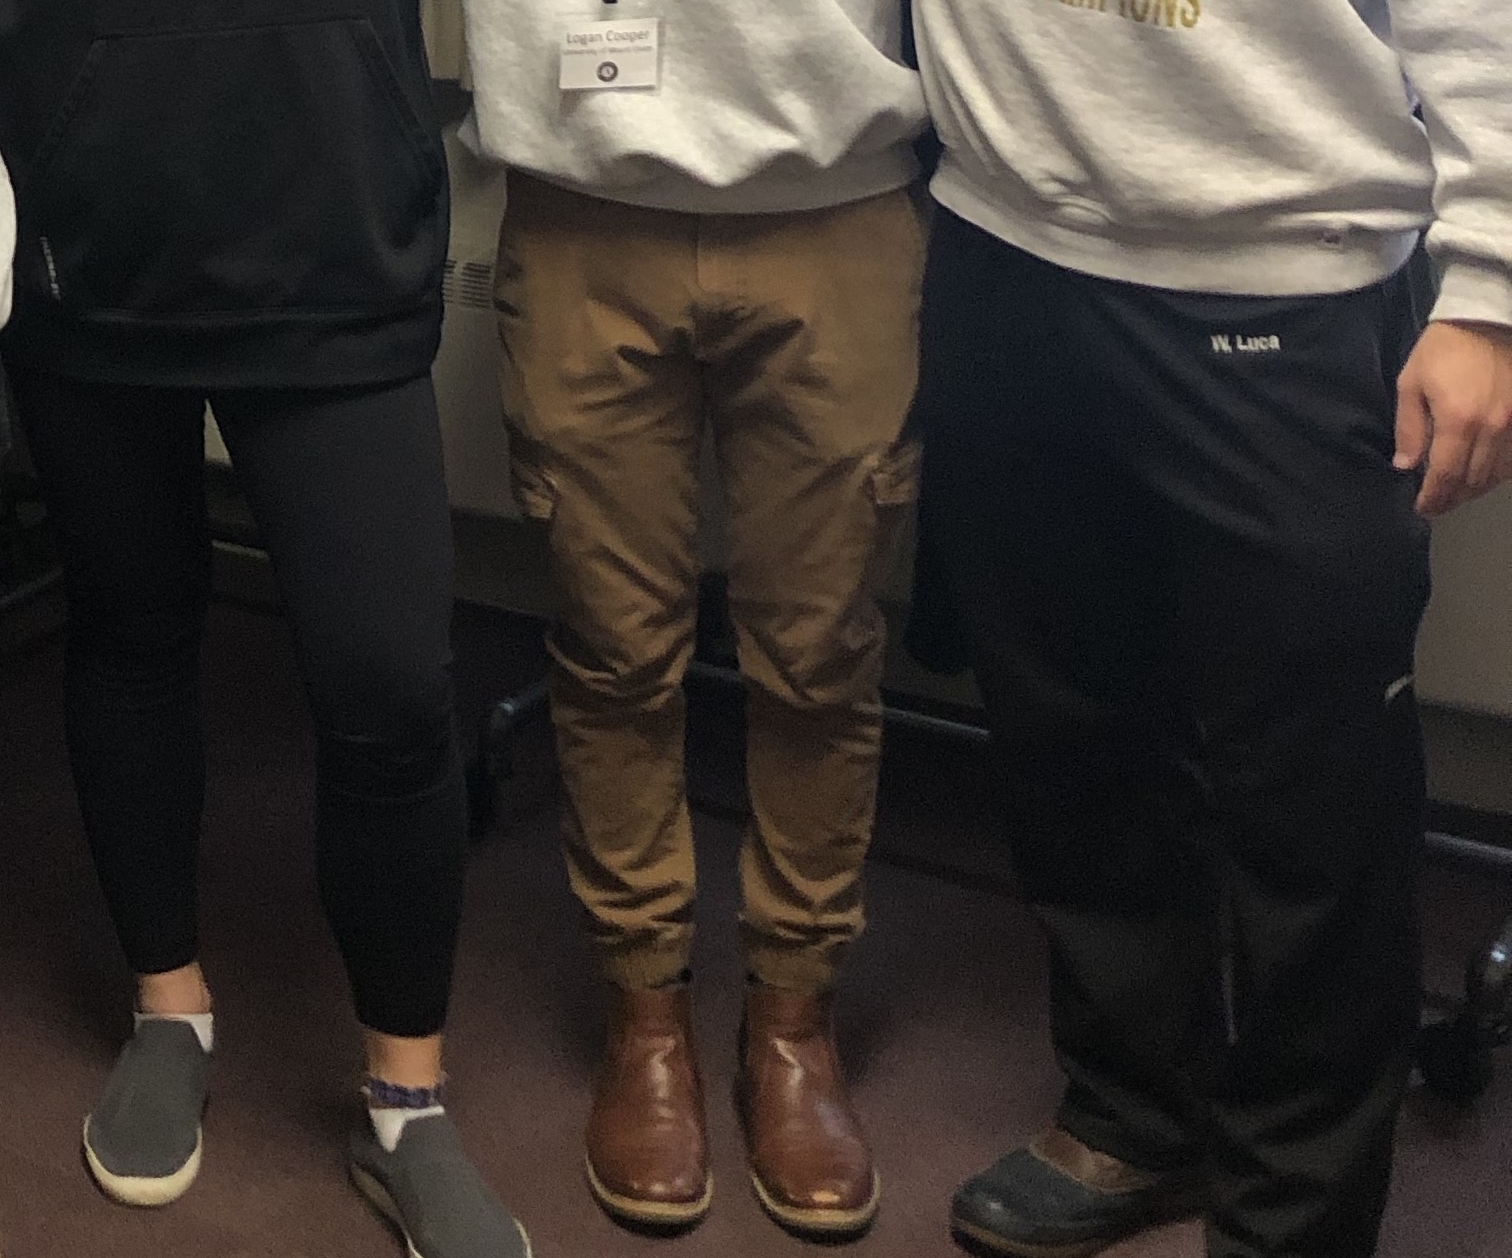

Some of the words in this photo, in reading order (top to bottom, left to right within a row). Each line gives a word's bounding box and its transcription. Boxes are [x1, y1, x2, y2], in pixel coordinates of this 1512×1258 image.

[566, 33, 603, 45] Logan
[606, 29, 650, 43] Cooper
[1236, 334, 1280, 352] Luca
